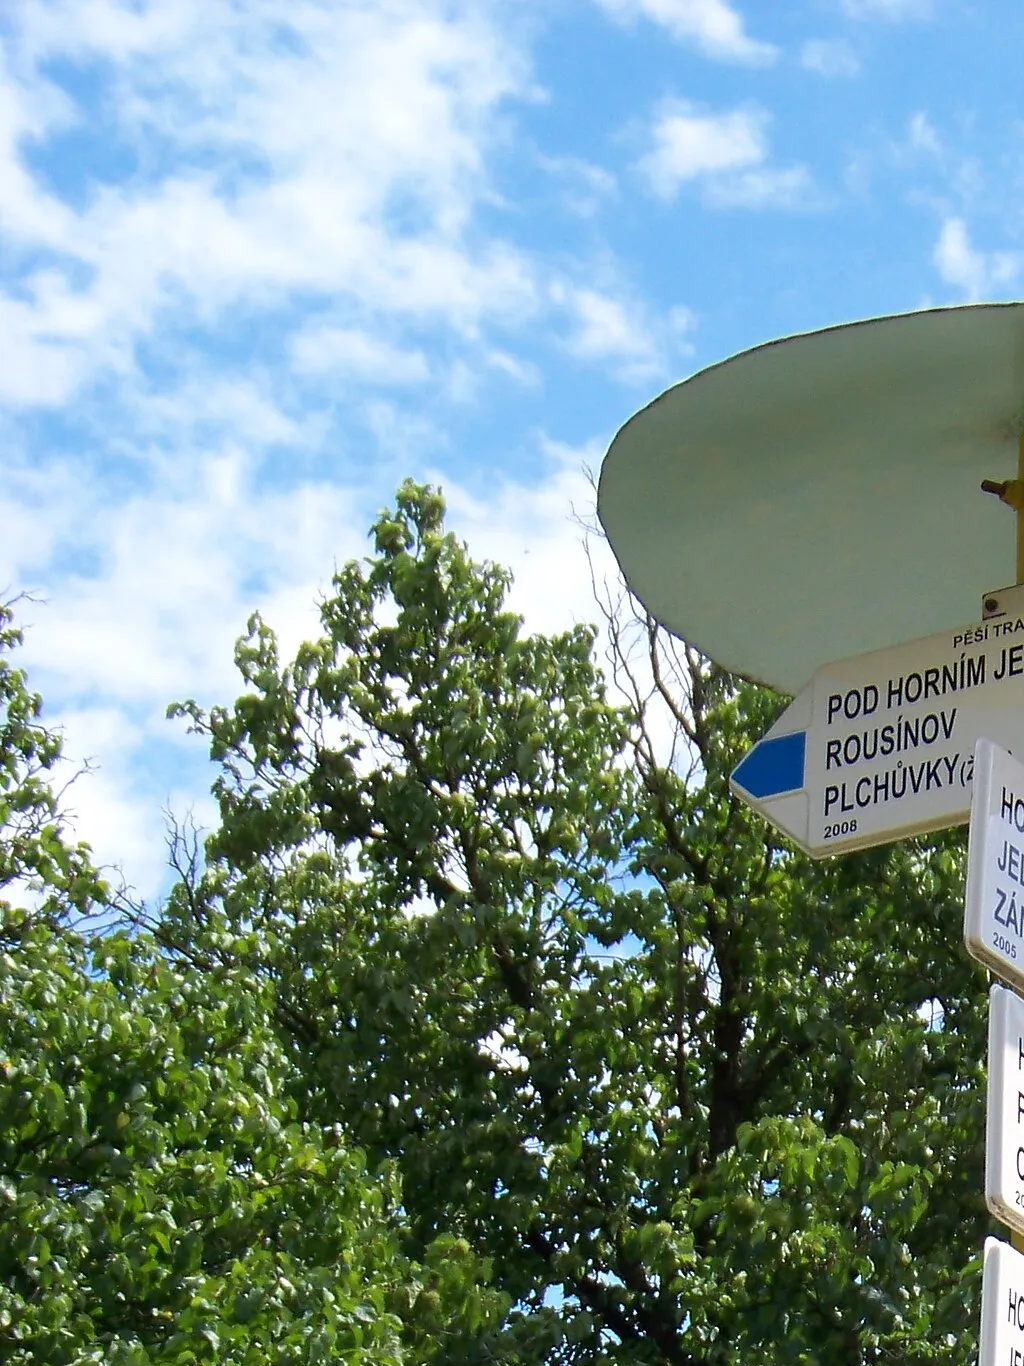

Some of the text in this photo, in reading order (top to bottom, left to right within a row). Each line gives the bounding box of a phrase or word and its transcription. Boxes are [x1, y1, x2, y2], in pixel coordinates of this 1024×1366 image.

[953, 624, 989, 648] PĚŠÍ
[827, 684, 879, 724] POD
[887, 654, 986, 709] HORNÍM
[826, 709, 957, 770] ROUSÍNOV
[823, 820, 858, 839] 2008
[993, 932, 1017, 959] 2005
